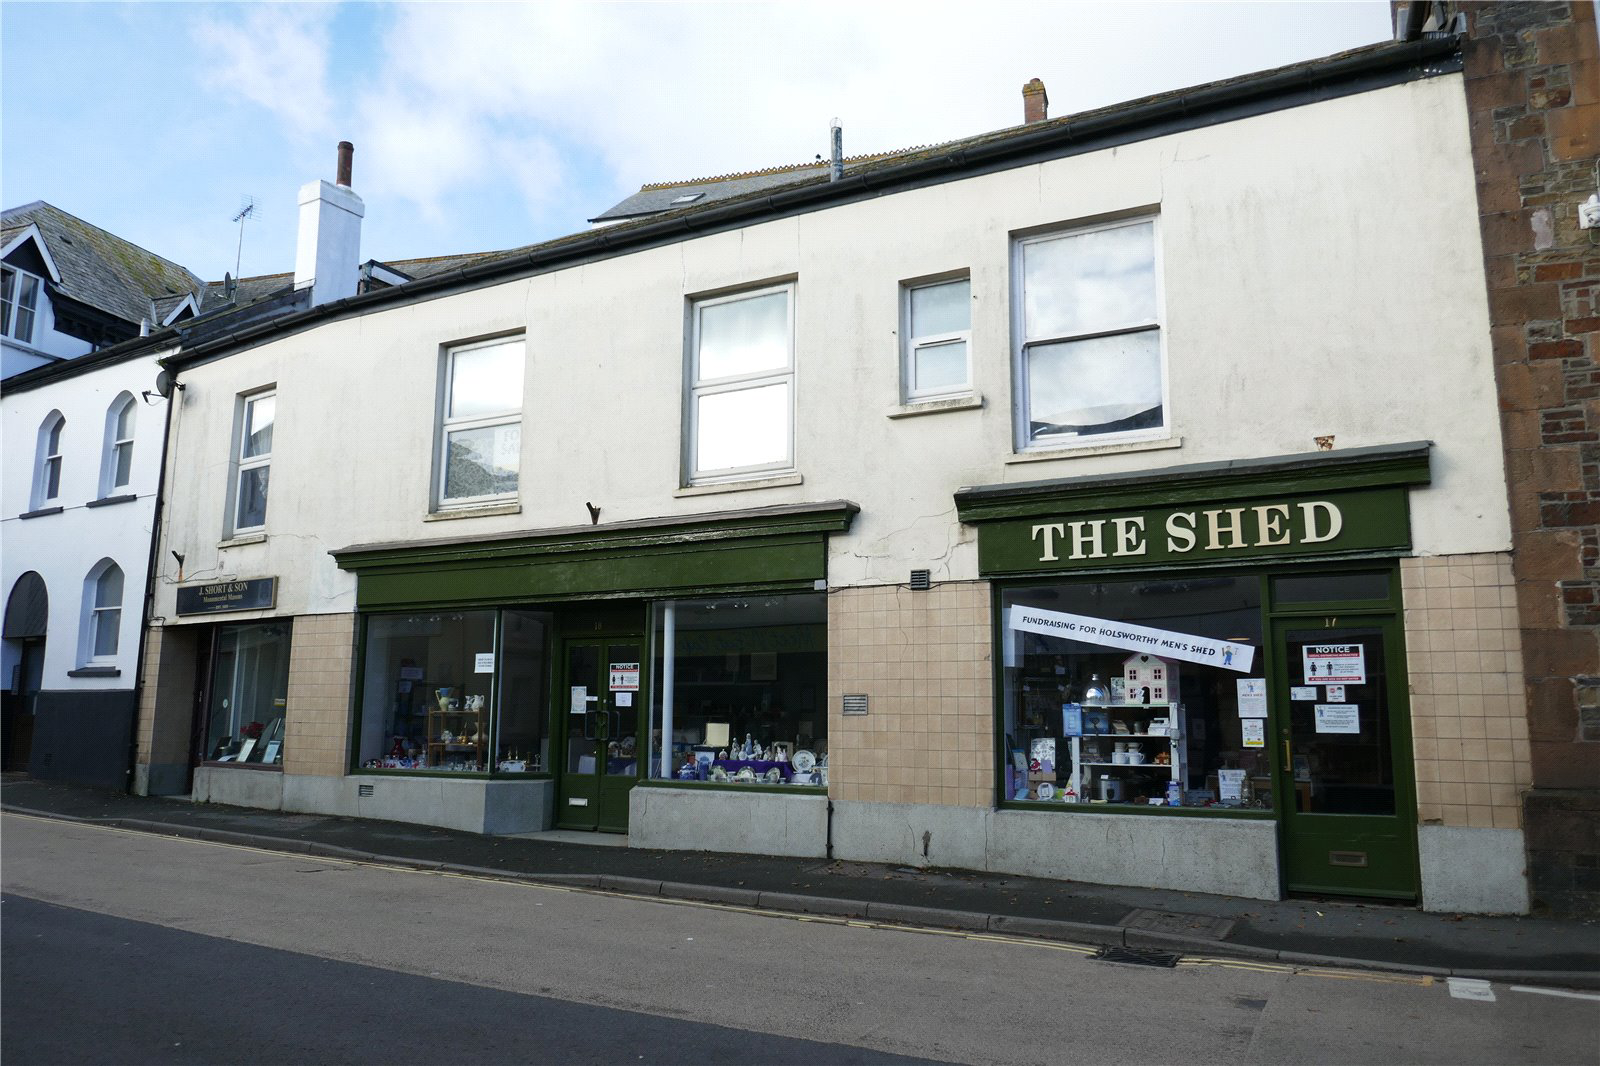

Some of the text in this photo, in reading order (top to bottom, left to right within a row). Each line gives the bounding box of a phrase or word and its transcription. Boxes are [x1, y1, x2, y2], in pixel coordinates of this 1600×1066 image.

[1031, 501, 1343, 562] THE SHED
[205, 584, 228, 595] SHORT
[228, 583, 233, 593] &
[234, 582, 249, 592] SON
[1325, 617, 1336, 627] 17
[1022, 616, 1216, 656] FUNDRAISING FOR HOLSWORTHY MEN'S SHED
[1315, 646, 1351, 654] NOTICE
